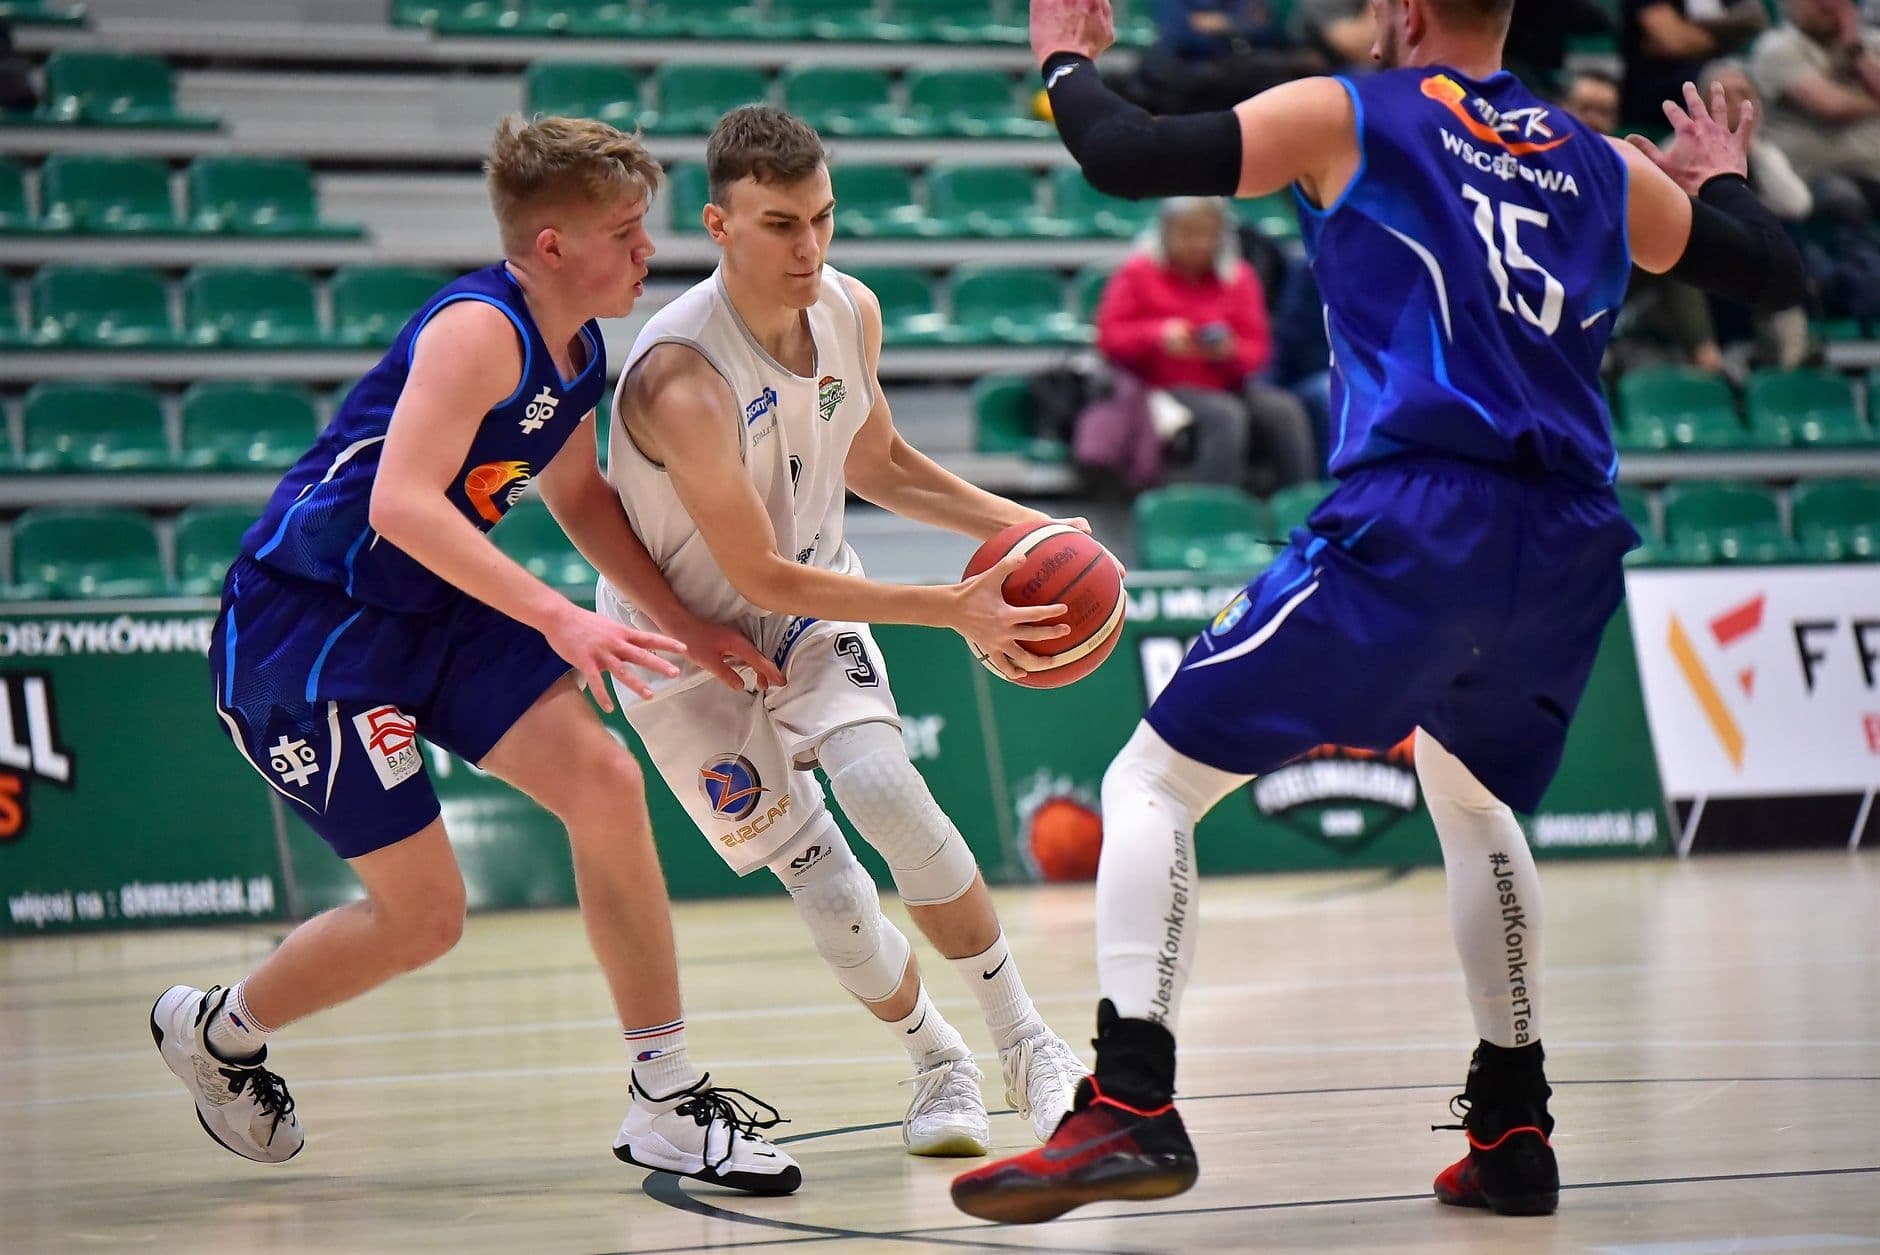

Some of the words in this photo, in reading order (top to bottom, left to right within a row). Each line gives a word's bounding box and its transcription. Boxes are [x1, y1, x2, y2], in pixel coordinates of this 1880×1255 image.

[1461, 183, 1565, 336] 15
[834, 632, 879, 688] 3
[1488, 851, 1532, 1045] #JestKonkretTea
